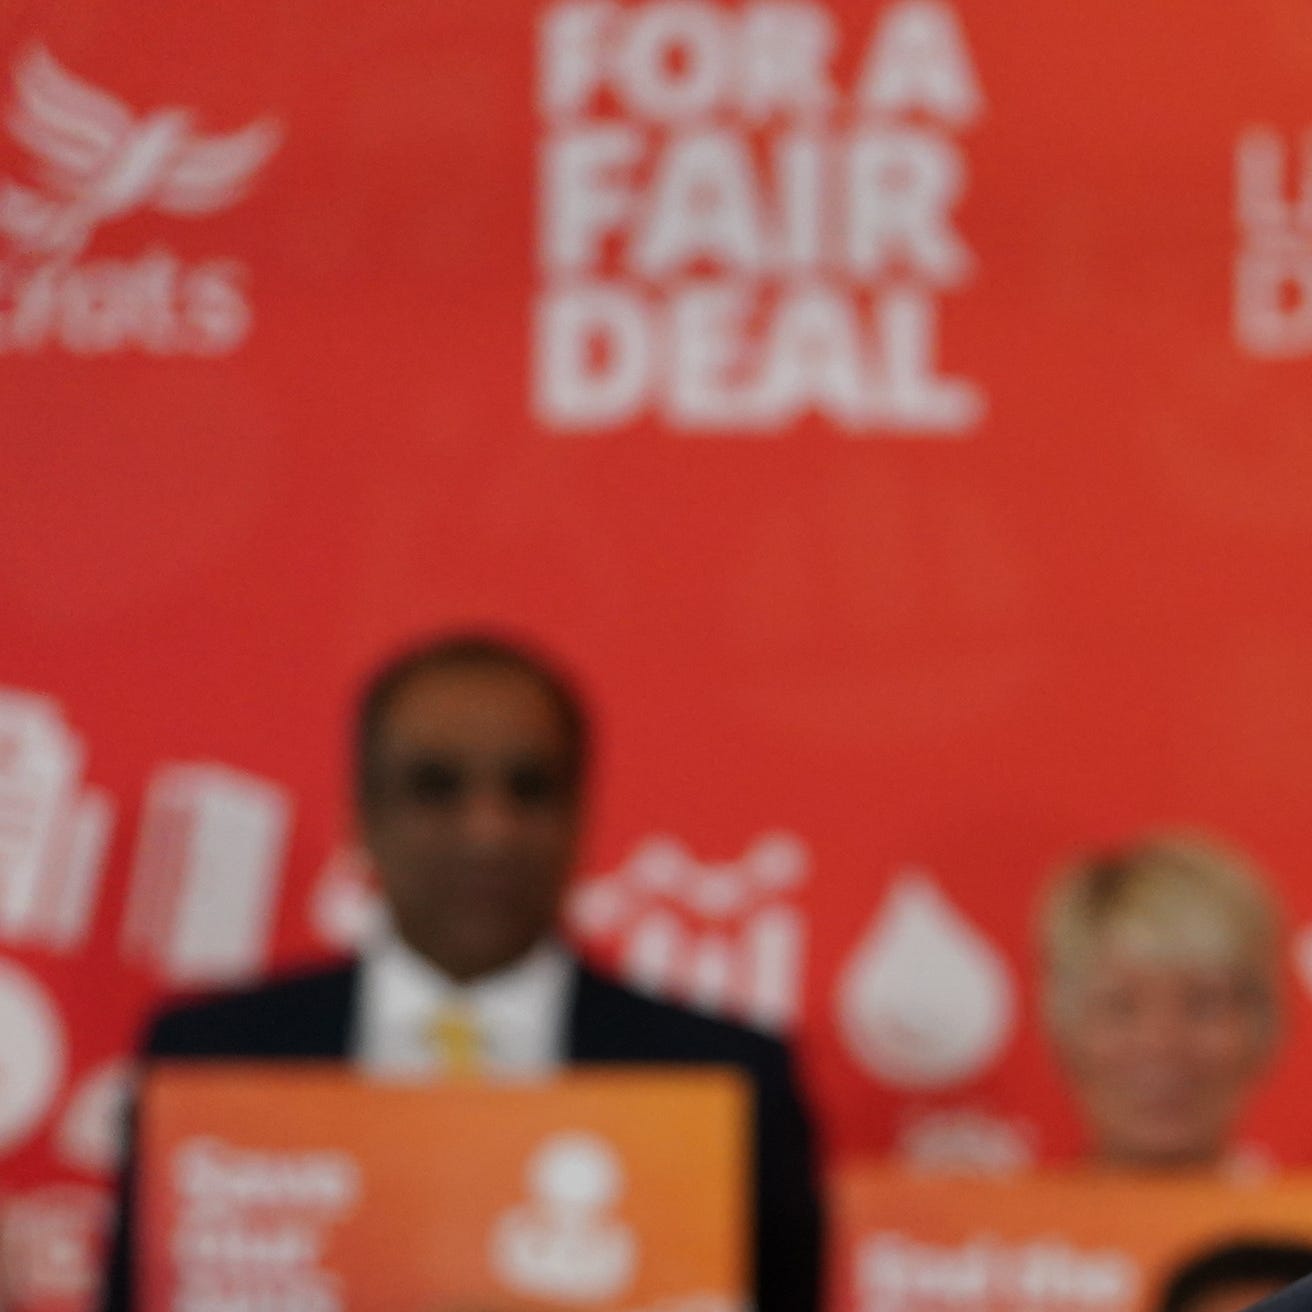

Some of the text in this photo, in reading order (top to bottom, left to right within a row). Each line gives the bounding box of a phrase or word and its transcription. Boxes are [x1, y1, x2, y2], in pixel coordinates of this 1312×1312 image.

[541, 0, 977, 120] FOR A
[540, 127, 968, 281] FAIR
[536, 284, 978, 430] DEAL
[178, 1143, 356, 1212] Save
[178, 1214, 324, 1276] Our
